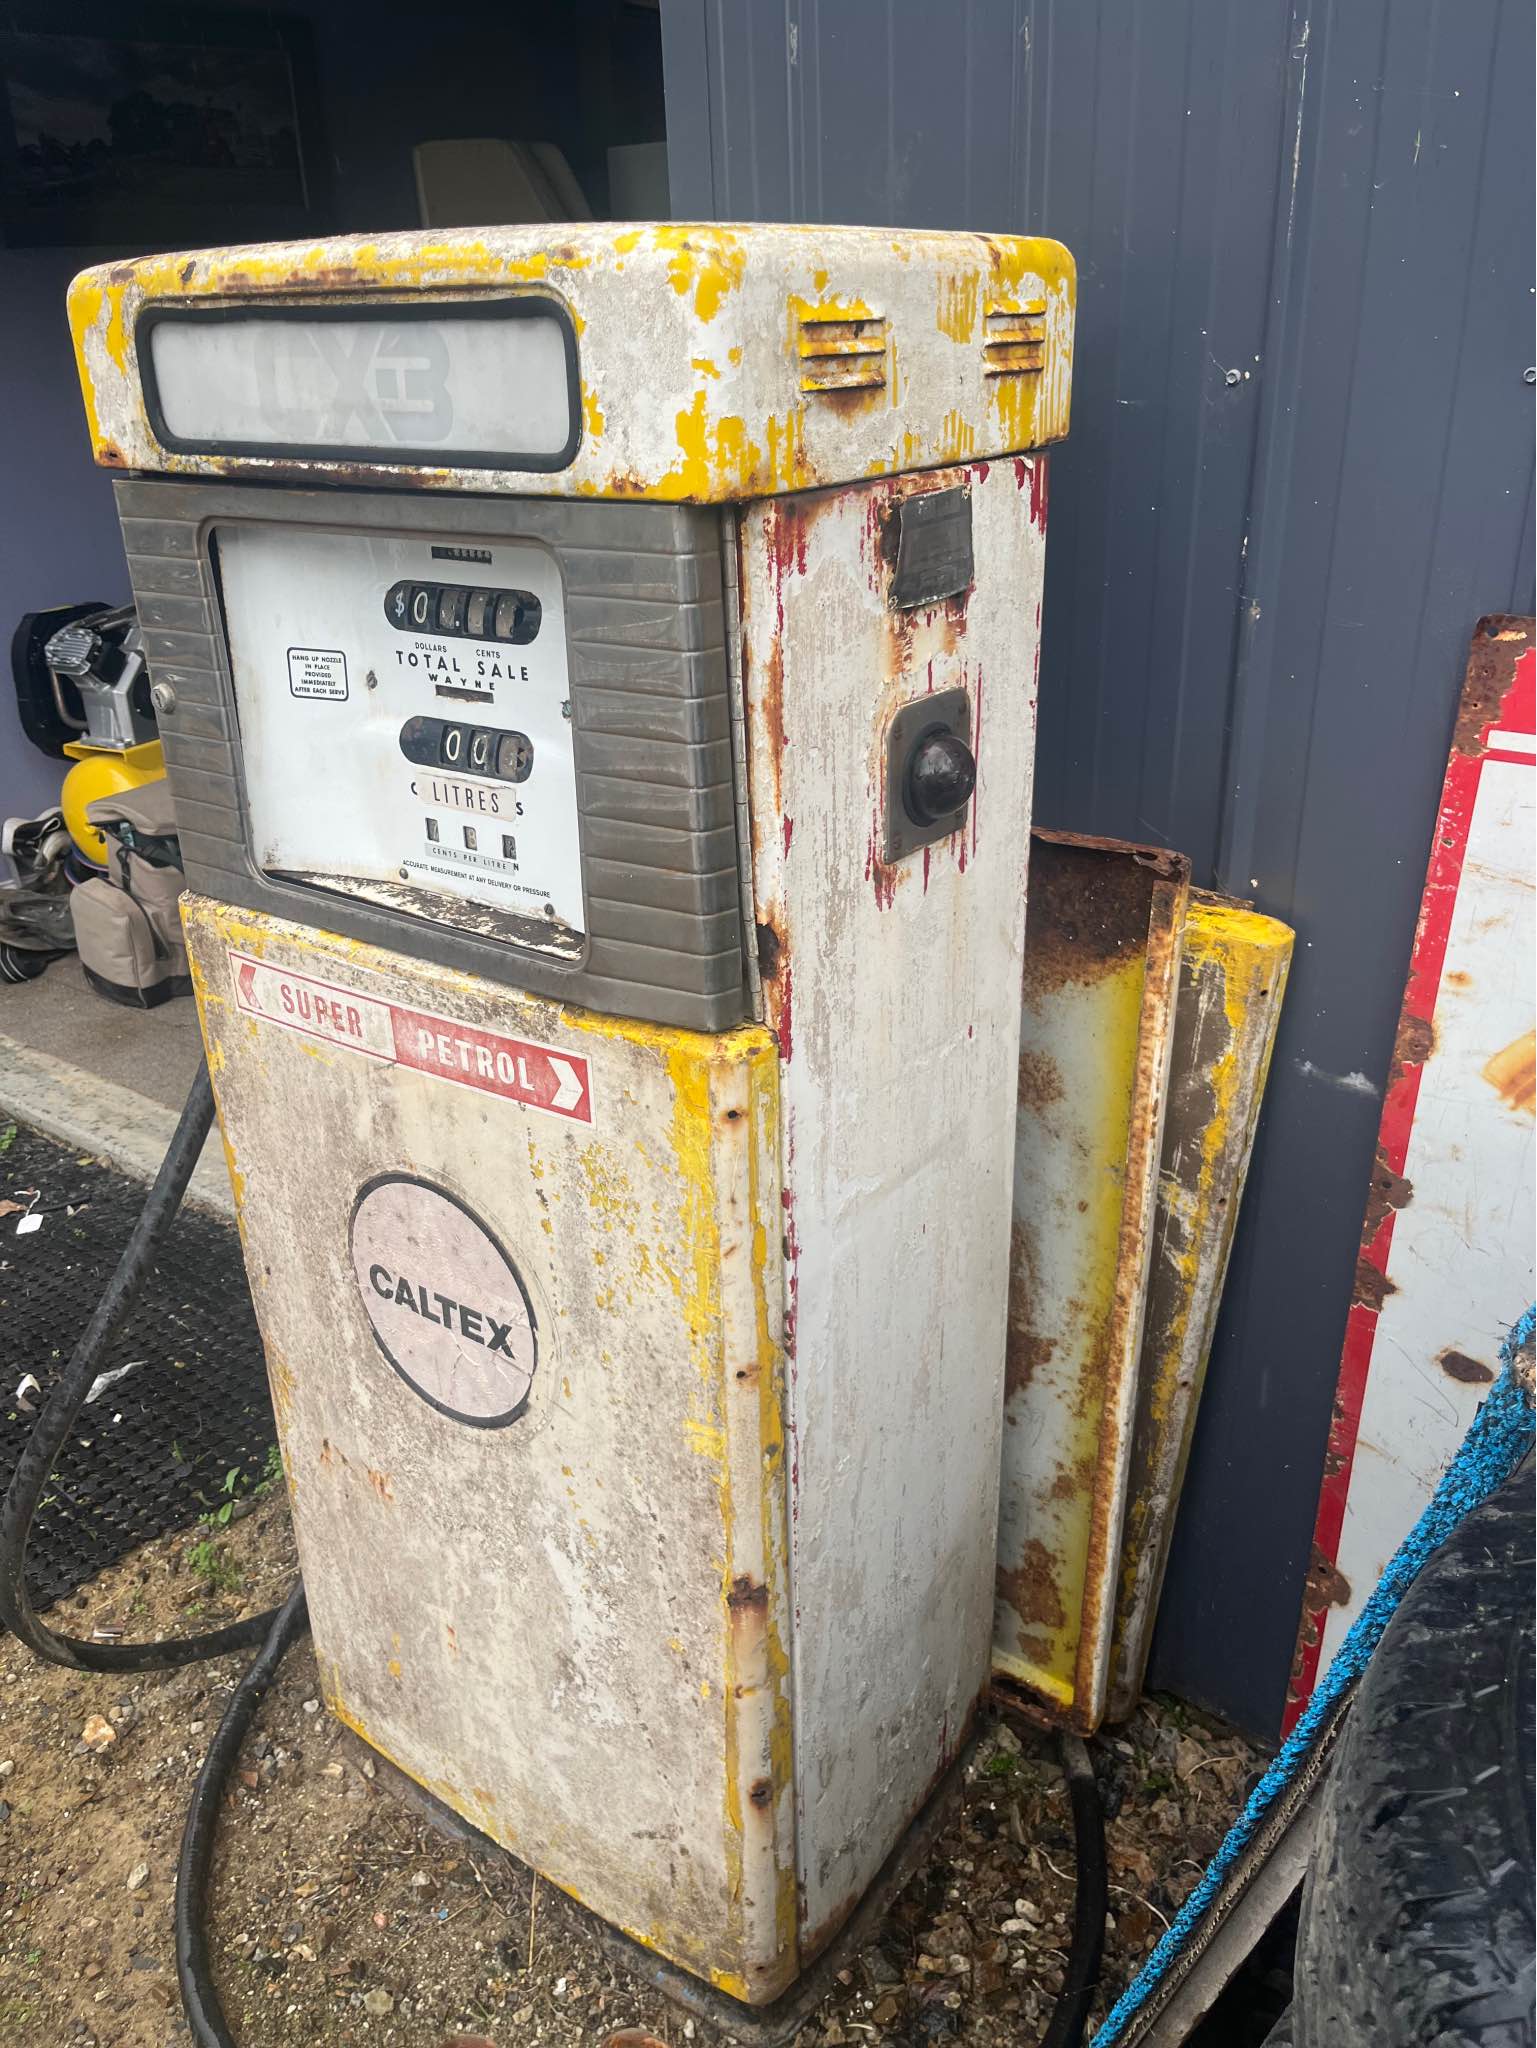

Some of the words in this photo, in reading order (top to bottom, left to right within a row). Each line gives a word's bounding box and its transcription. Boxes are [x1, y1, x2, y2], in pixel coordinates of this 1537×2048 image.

[395, 650, 460, 673] TOTAL
[477, 660, 529, 682] SALE
[415, 641, 447, 653] DOLLARS
[475, 649, 501, 659] CENTS
[301, 679, 336, 687] IMMEDIATELY
[428, 673, 495, 691] WAYNE
[433, 781, 499, 813] LITRES
[432, 847, 457, 858] CENTS
[463, 854, 477, 862] PER
[483, 859, 506, 869] LITRE
[402, 859, 429, 871] ACCURATE
[430, 865, 467, 879] MEASUREMENT
[476, 876, 487, 884] ANY
[487, 878, 512, 889] DELIVERY
[513, 884, 521, 892] OR
[522, 886, 551, 898] PRESSURE
[280, 984, 362, 1038] SUPER
[416, 1027, 536, 1091] PETROL
[369, 1263, 516, 1360] CALTEX
